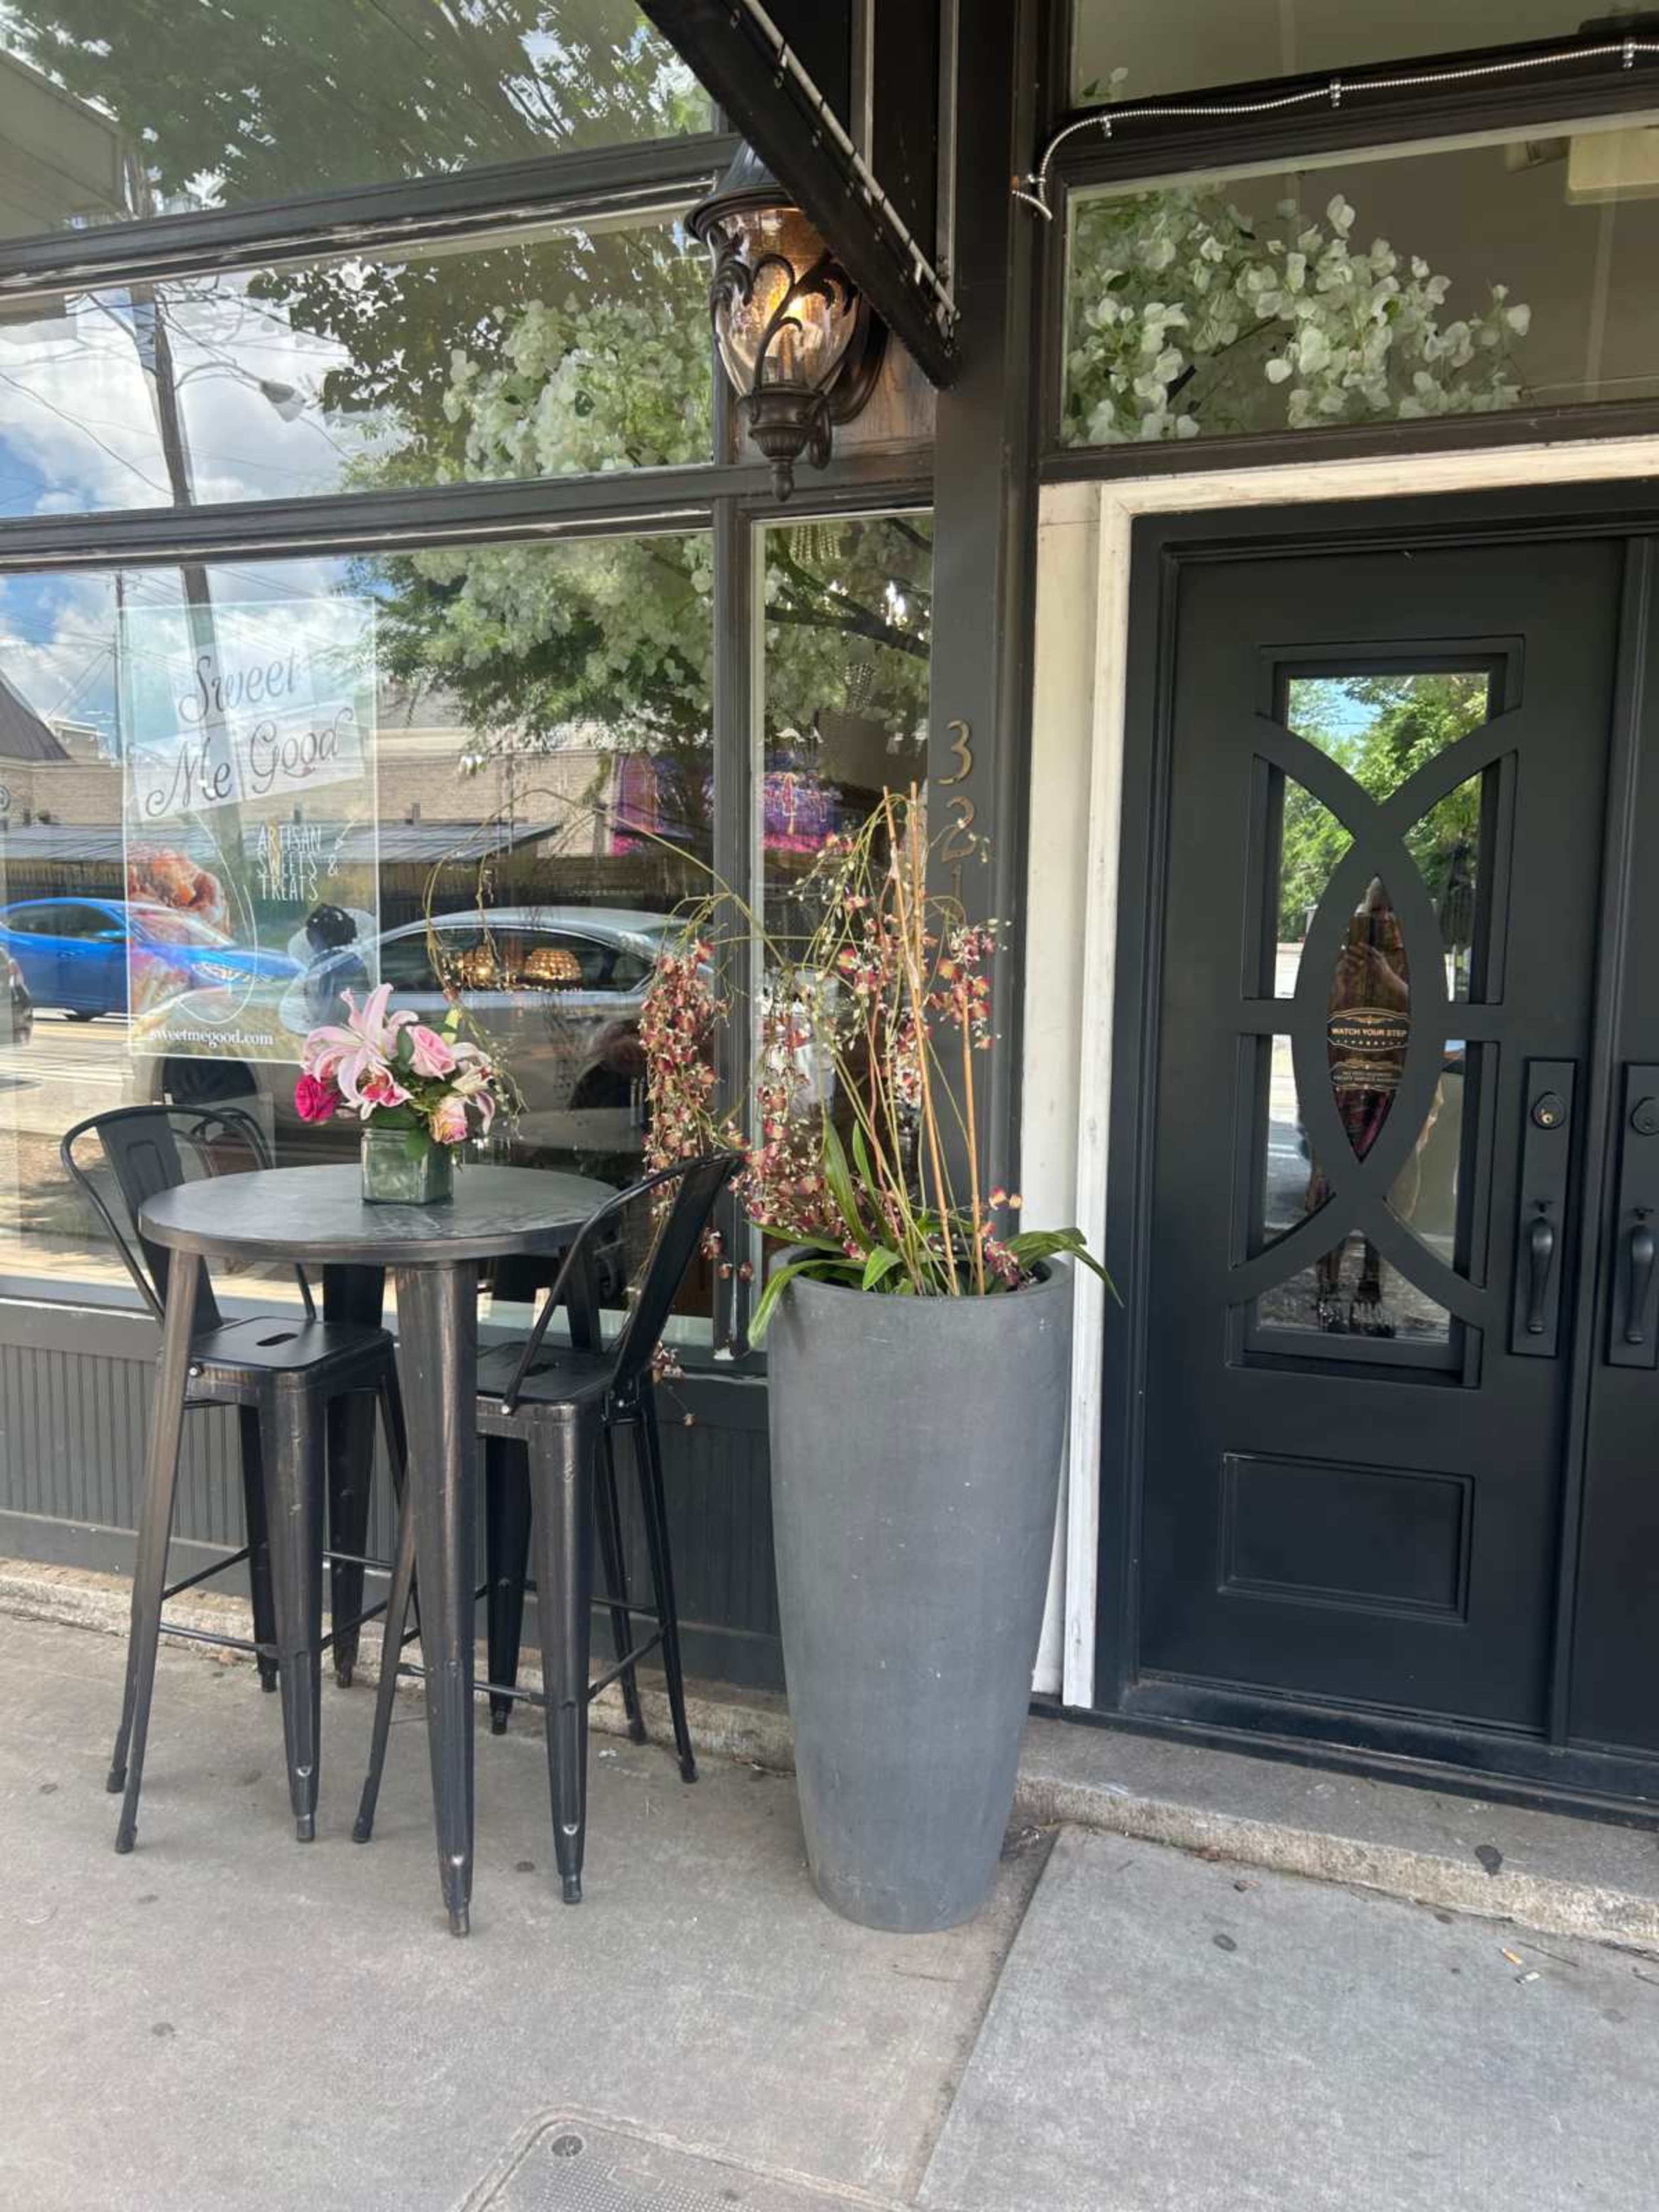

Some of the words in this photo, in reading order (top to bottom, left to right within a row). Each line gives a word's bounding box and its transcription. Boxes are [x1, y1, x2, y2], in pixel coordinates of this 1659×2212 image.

[178, 647, 299, 724] Sweet
[146, 736, 233, 817] Me
[249, 707, 354, 794] Good
[256, 825, 321, 852] ARTISAN
[256, 851, 318, 877] SWEETS
[258, 874, 318, 901] TREATS
[149, 1028, 274, 1048] sweetmegood.com
[1331, 1027, 1360, 1036] WATCH
[1362, 1028, 1385, 1036] YOUR
[1386, 1029, 1407, 1037] STEP
